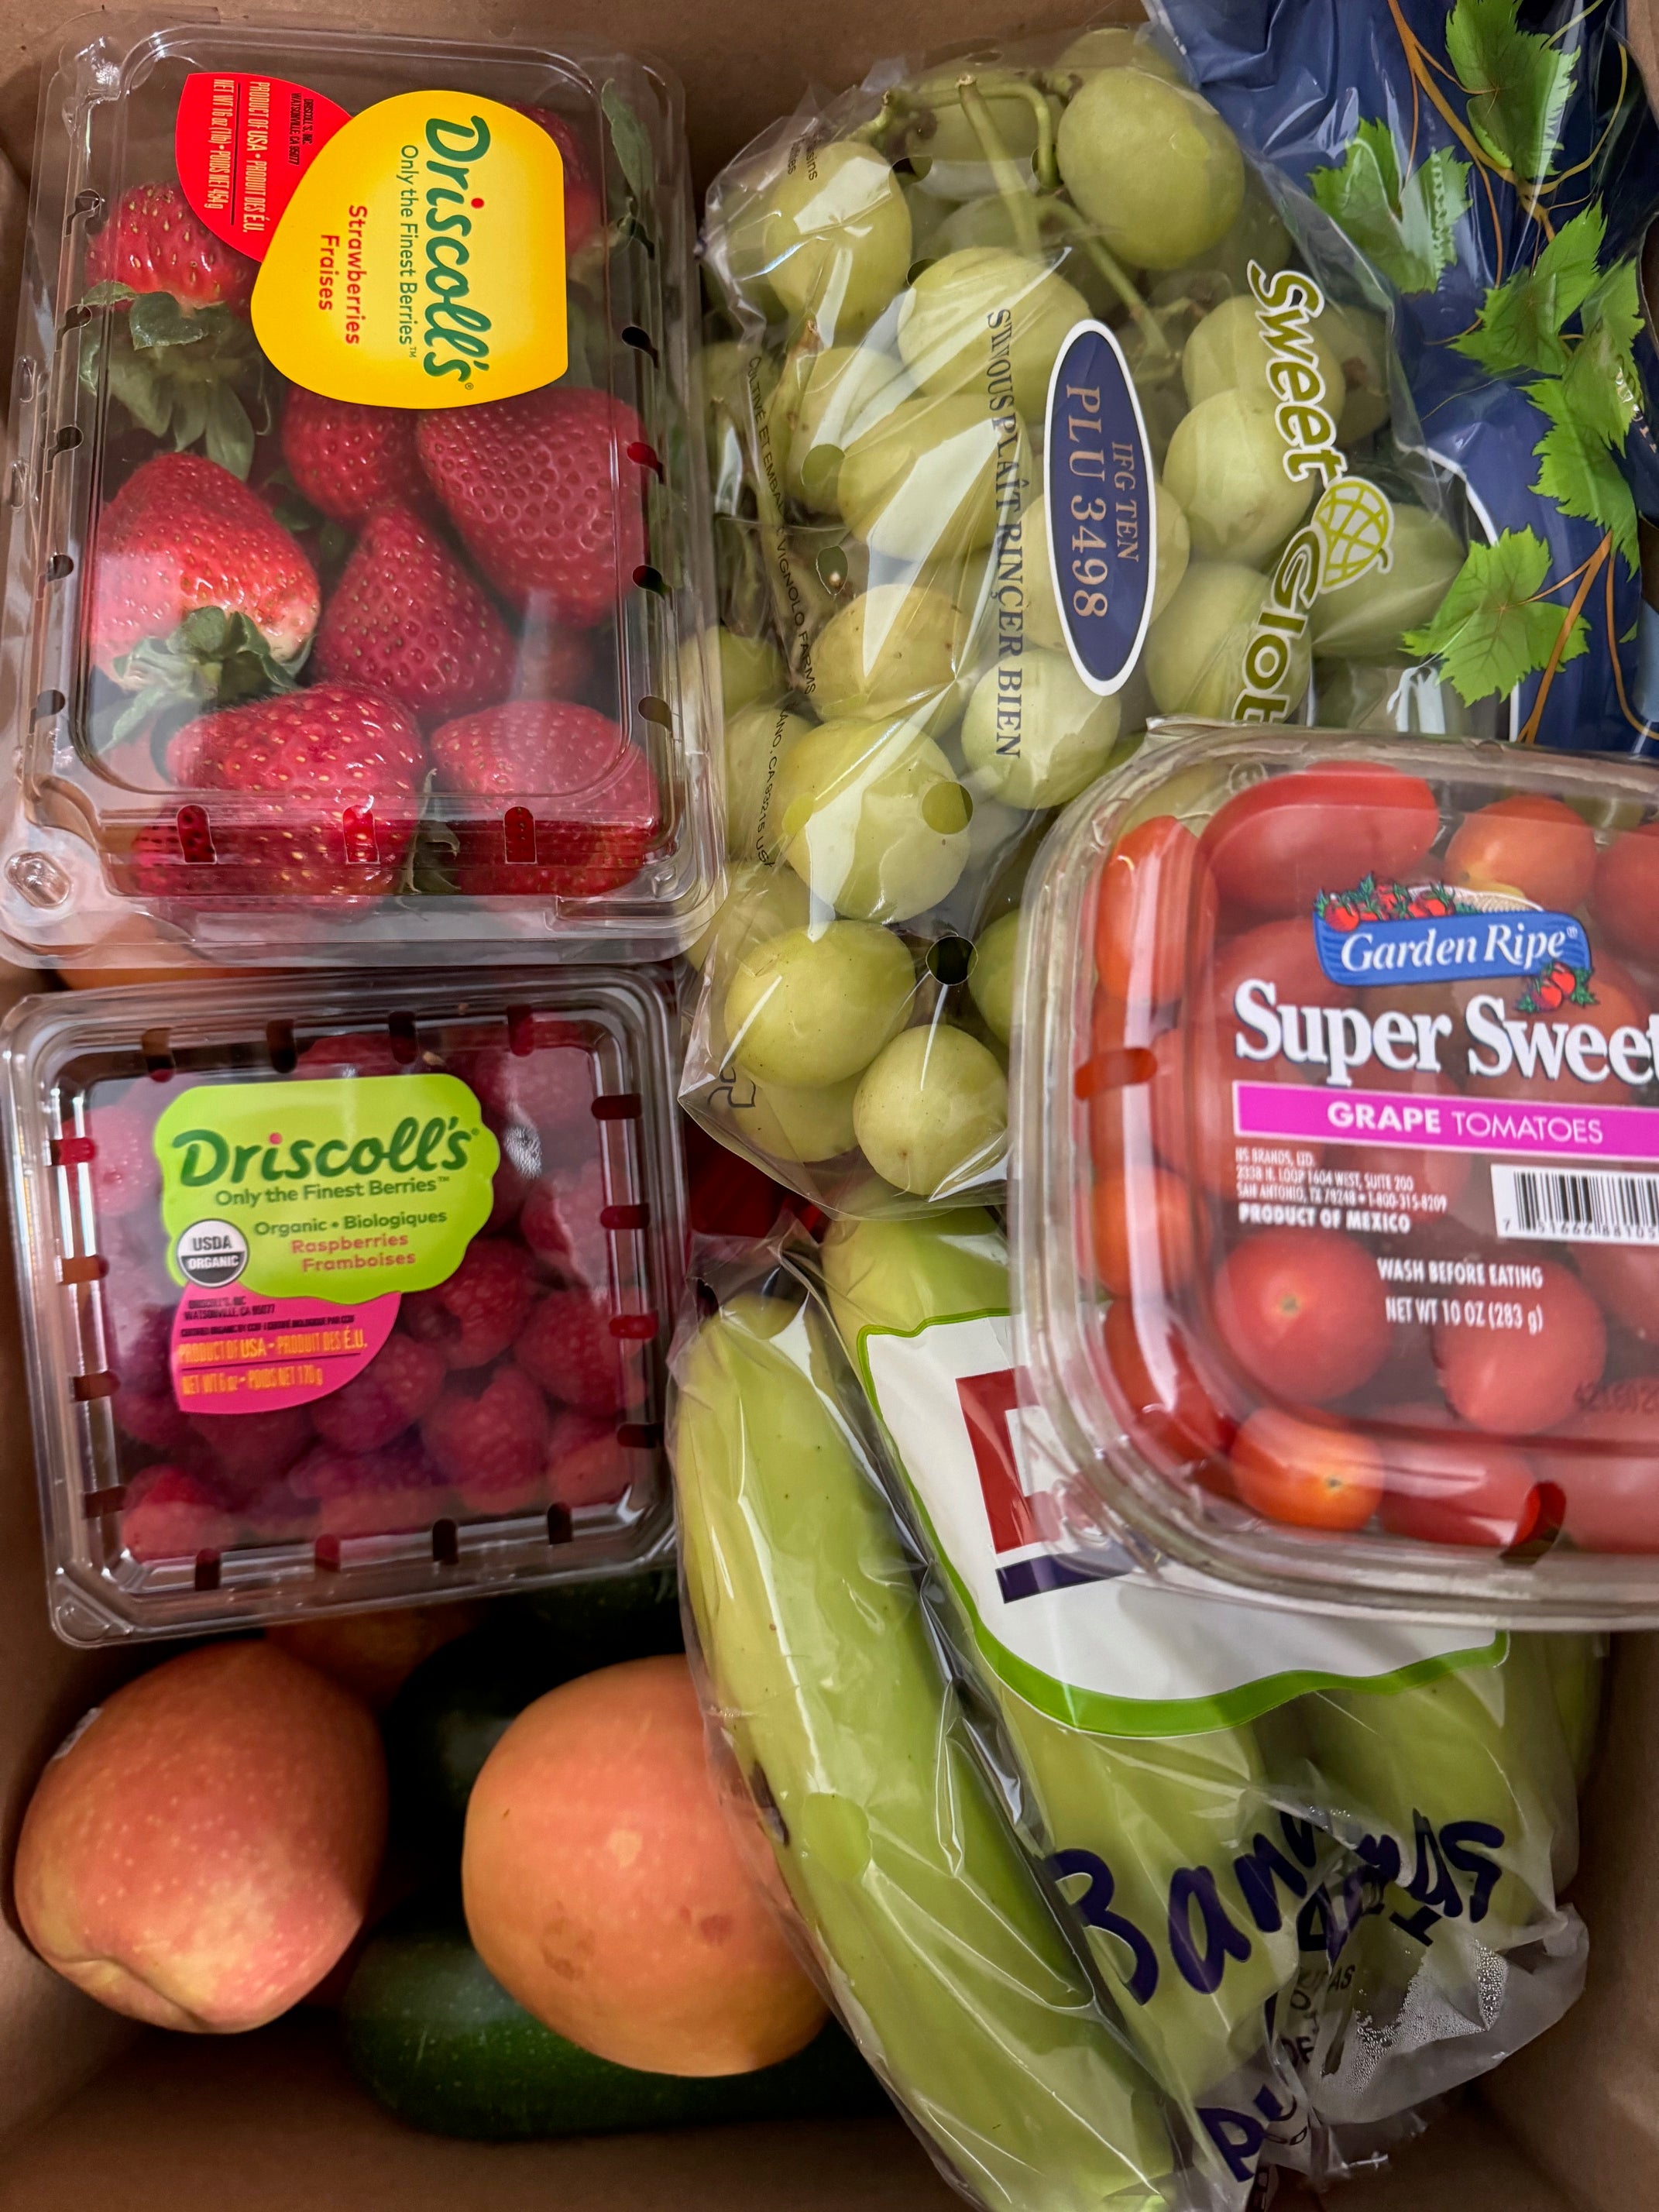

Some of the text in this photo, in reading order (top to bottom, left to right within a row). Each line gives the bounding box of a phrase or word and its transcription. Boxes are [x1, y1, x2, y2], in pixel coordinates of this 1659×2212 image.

[213, 95, 233, 106] WT
[214, 80, 234, 91] NET
[211, 118, 227, 126] oz
[210, 150, 231, 173] POIDS
[243, 82, 270, 232] PRODUCT OF USA PRODUIT DES É.U.
[289, 146, 299, 165] 95077
[397, 146, 418, 186] Only
[208, 174, 230, 188] NET
[400, 188, 418, 218] the
[400, 224, 417, 276] Finest
[318, 235, 339, 311] Fraises
[345, 205, 367, 345] Strawberries
[1245, 259, 1348, 490] Sweet
[758, 426, 771, 449] ET
[992, 414, 1029, 513] PLAÎT
[1066, 384, 1108, 617] PLU 3498
[1111, 441, 1139, 562] IFG TEN
[989, 521, 1023, 658] RINÇER
[777, 538, 816, 694] VIGNOLO FARMS
[994, 667, 1022, 757] BIEN
[766, 756, 778, 782] CA
[757, 783, 773, 834] 93215
[1341, 928, 1477, 972] Garden
[1234, 979, 1452, 1087] Super
[1327, 1101, 1603, 1144] GRAPE TOMATOES
[1252, 1149, 1293, 1166] BRANDS,
[1237, 1182, 1256, 1198] SAN
[1279, 1167, 1304, 1183] LOOP
[1307, 1170, 1332, 1185] 1604
[1334, 1171, 1362, 1190] WEST,
[1365, 1173, 1391, 1189] SUITE
[1395, 1175, 1413, 1191] 200
[215, 1190, 265, 1208] Only
[266, 1187, 298, 1204] the
[304, 1183, 364, 1200] Finest
[254, 1211, 447, 1238] Organic Biologiques
[1238, 1203, 1411, 1234] PRODUCT OF MEXICO
[192, 1235, 232, 1252] USDA
[291, 1233, 408, 1255] Raspberries
[187, 1255, 239, 1271] ORGANIC
[302, 1251, 416, 1272] Framboises
[1378, 1258, 1544, 1288] WASH BEFORE EATING
[1386, 1297, 1544, 1335] NET WT 10 OZ (283 g)
[178, 1340, 222, 1364] PRODUCT
[222, 1339, 239, 1360] OF
[240, 1338, 266, 1358] USA
[276, 1333, 321, 1355] PRODUIT
[324, 1331, 340, 1351] DES
[182, 1375, 200, 1395] NET
